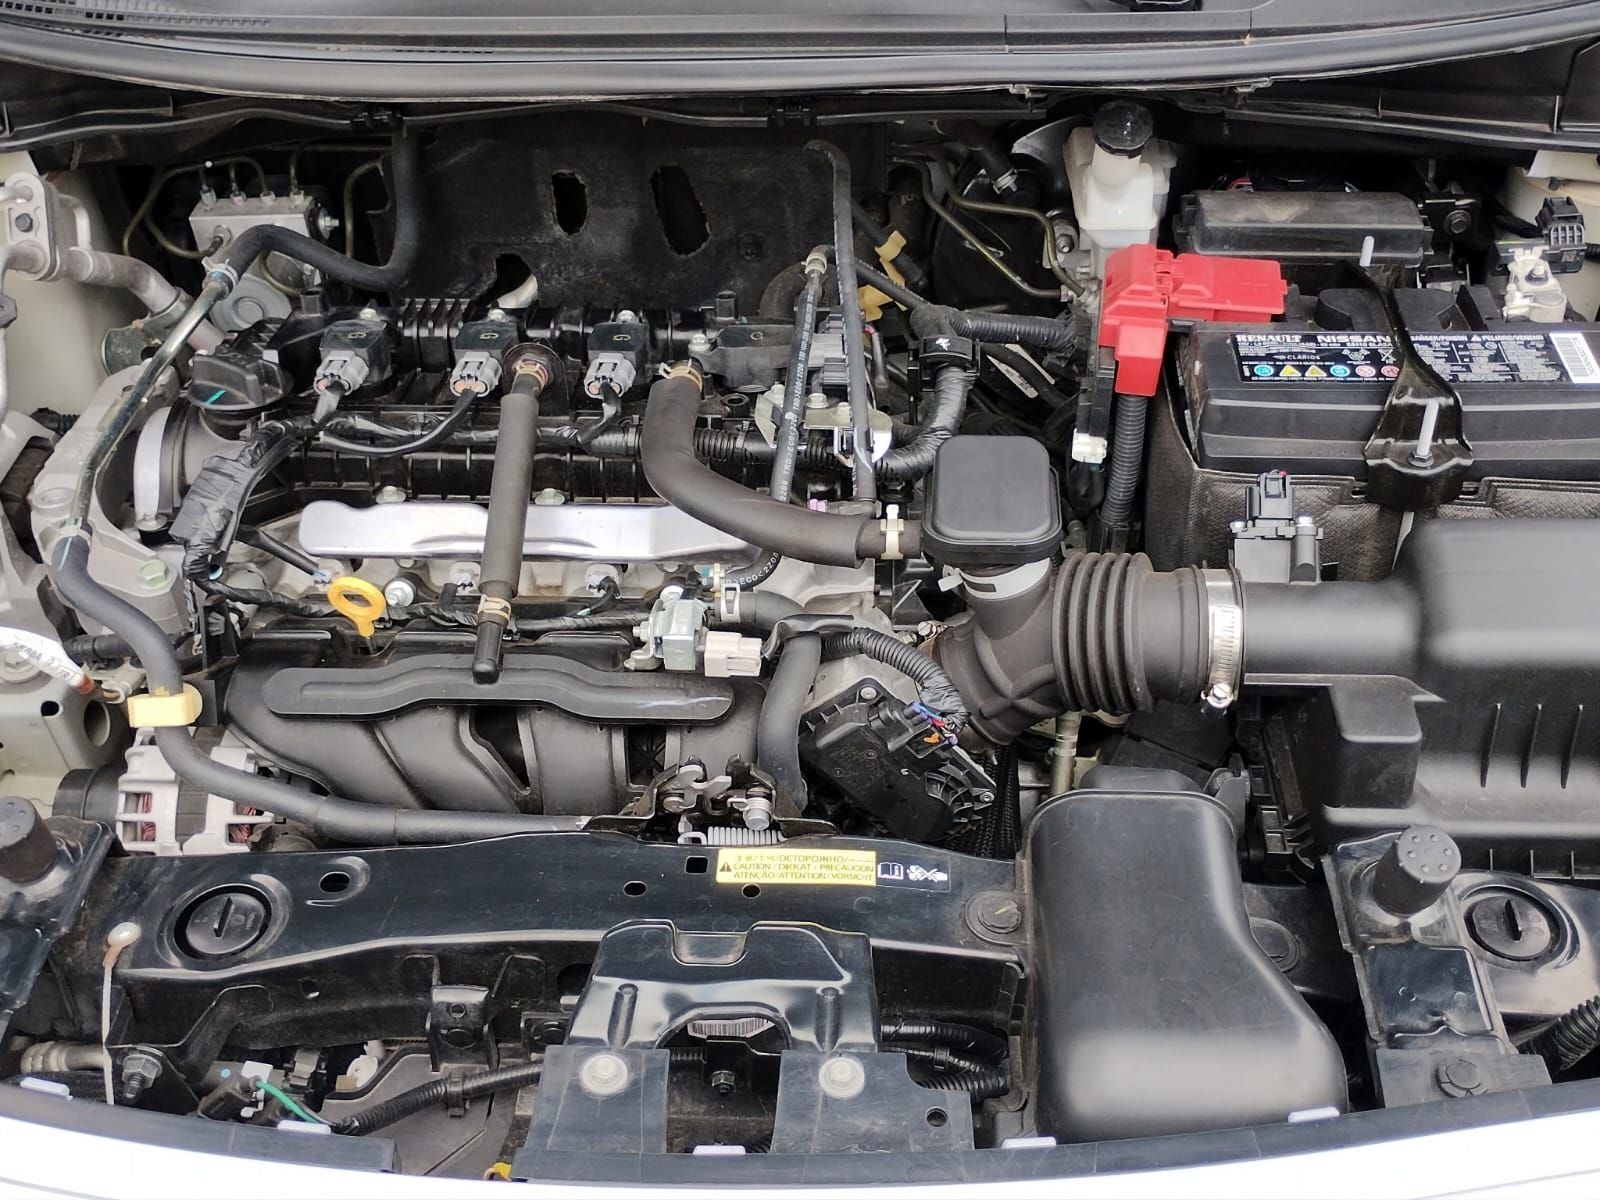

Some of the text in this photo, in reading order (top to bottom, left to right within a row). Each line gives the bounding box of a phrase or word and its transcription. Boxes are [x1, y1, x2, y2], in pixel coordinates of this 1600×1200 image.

[1236, 334, 1392, 343] RENAULT NISSAN
[733, 863, 771, 871] CAUTION
